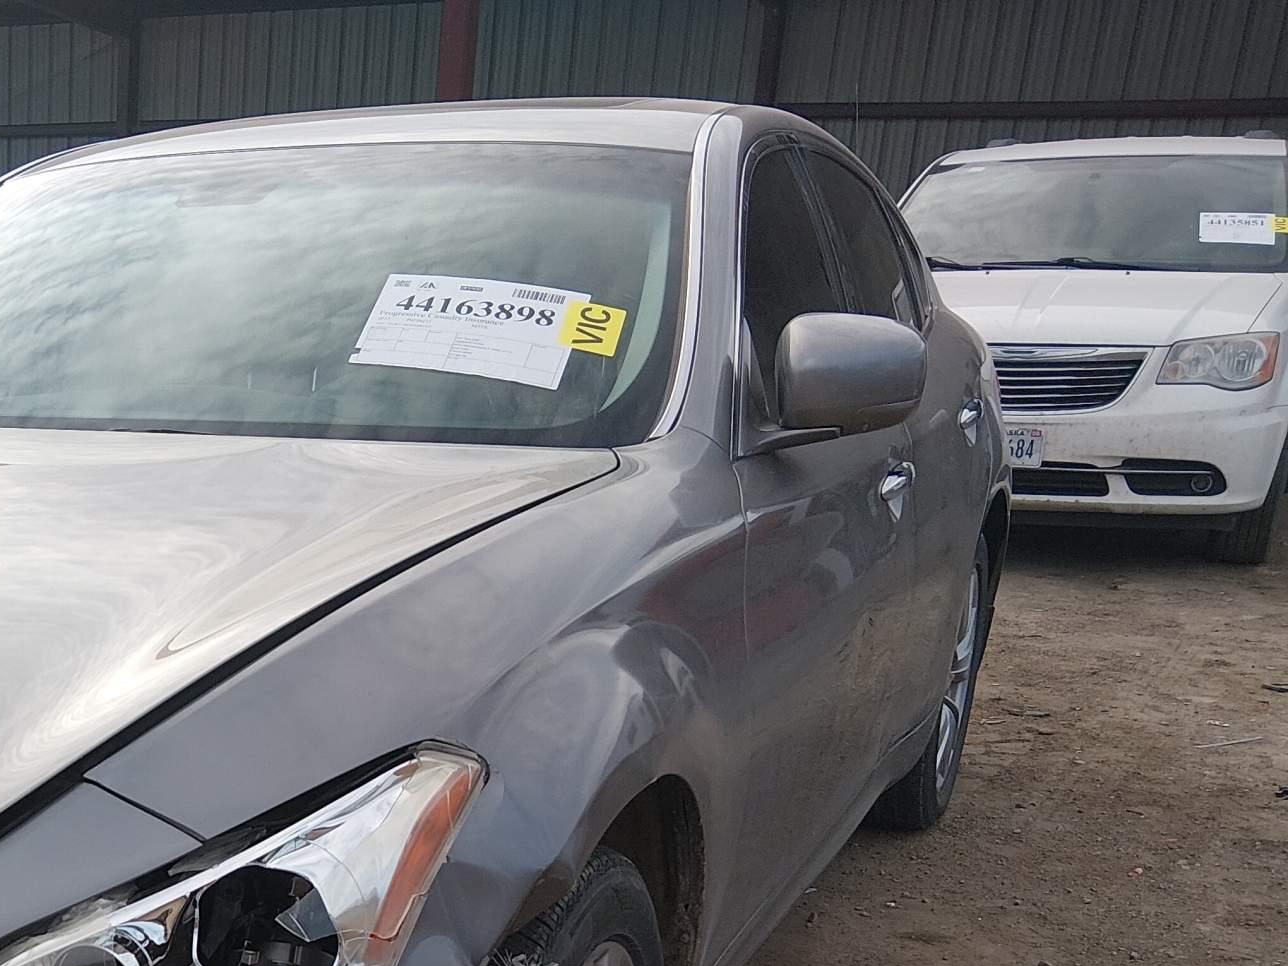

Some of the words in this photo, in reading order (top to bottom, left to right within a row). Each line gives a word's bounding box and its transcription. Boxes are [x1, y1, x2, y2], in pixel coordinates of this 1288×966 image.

[1274, 218, 1288, 231] VIC
[395, 295, 556, 327] 44163898
[571, 306, 612, 344] VIC
